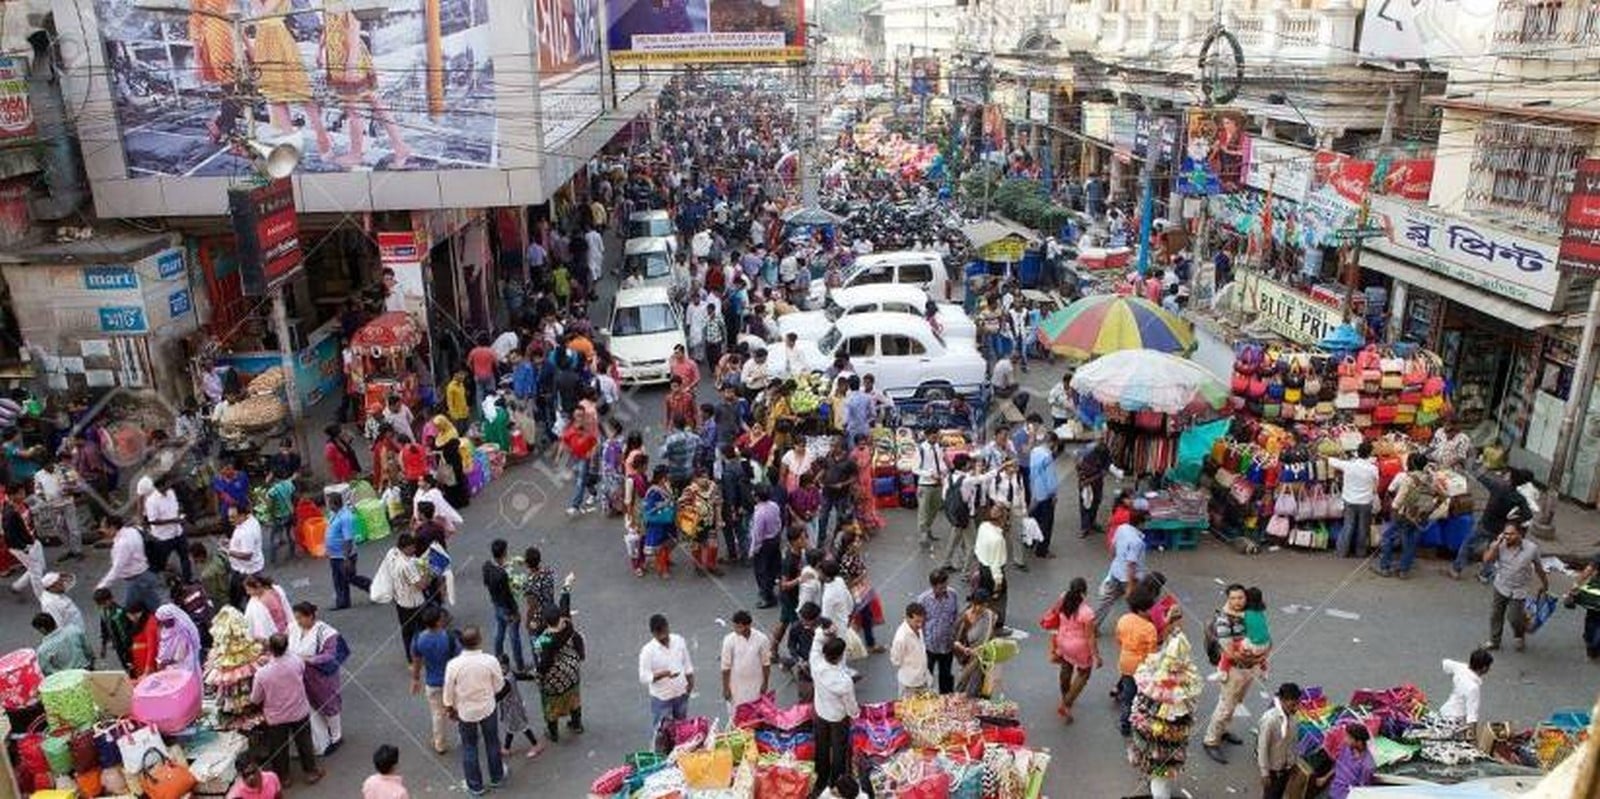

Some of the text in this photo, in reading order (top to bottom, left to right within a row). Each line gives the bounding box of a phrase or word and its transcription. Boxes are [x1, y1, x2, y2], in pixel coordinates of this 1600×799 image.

[1447, 225, 1553, 272] প্রিন্ট
[88, 272, 133, 286] mart
[1260, 292, 1295, 326] BLUE
[1300, 312, 1335, 339] PRI
